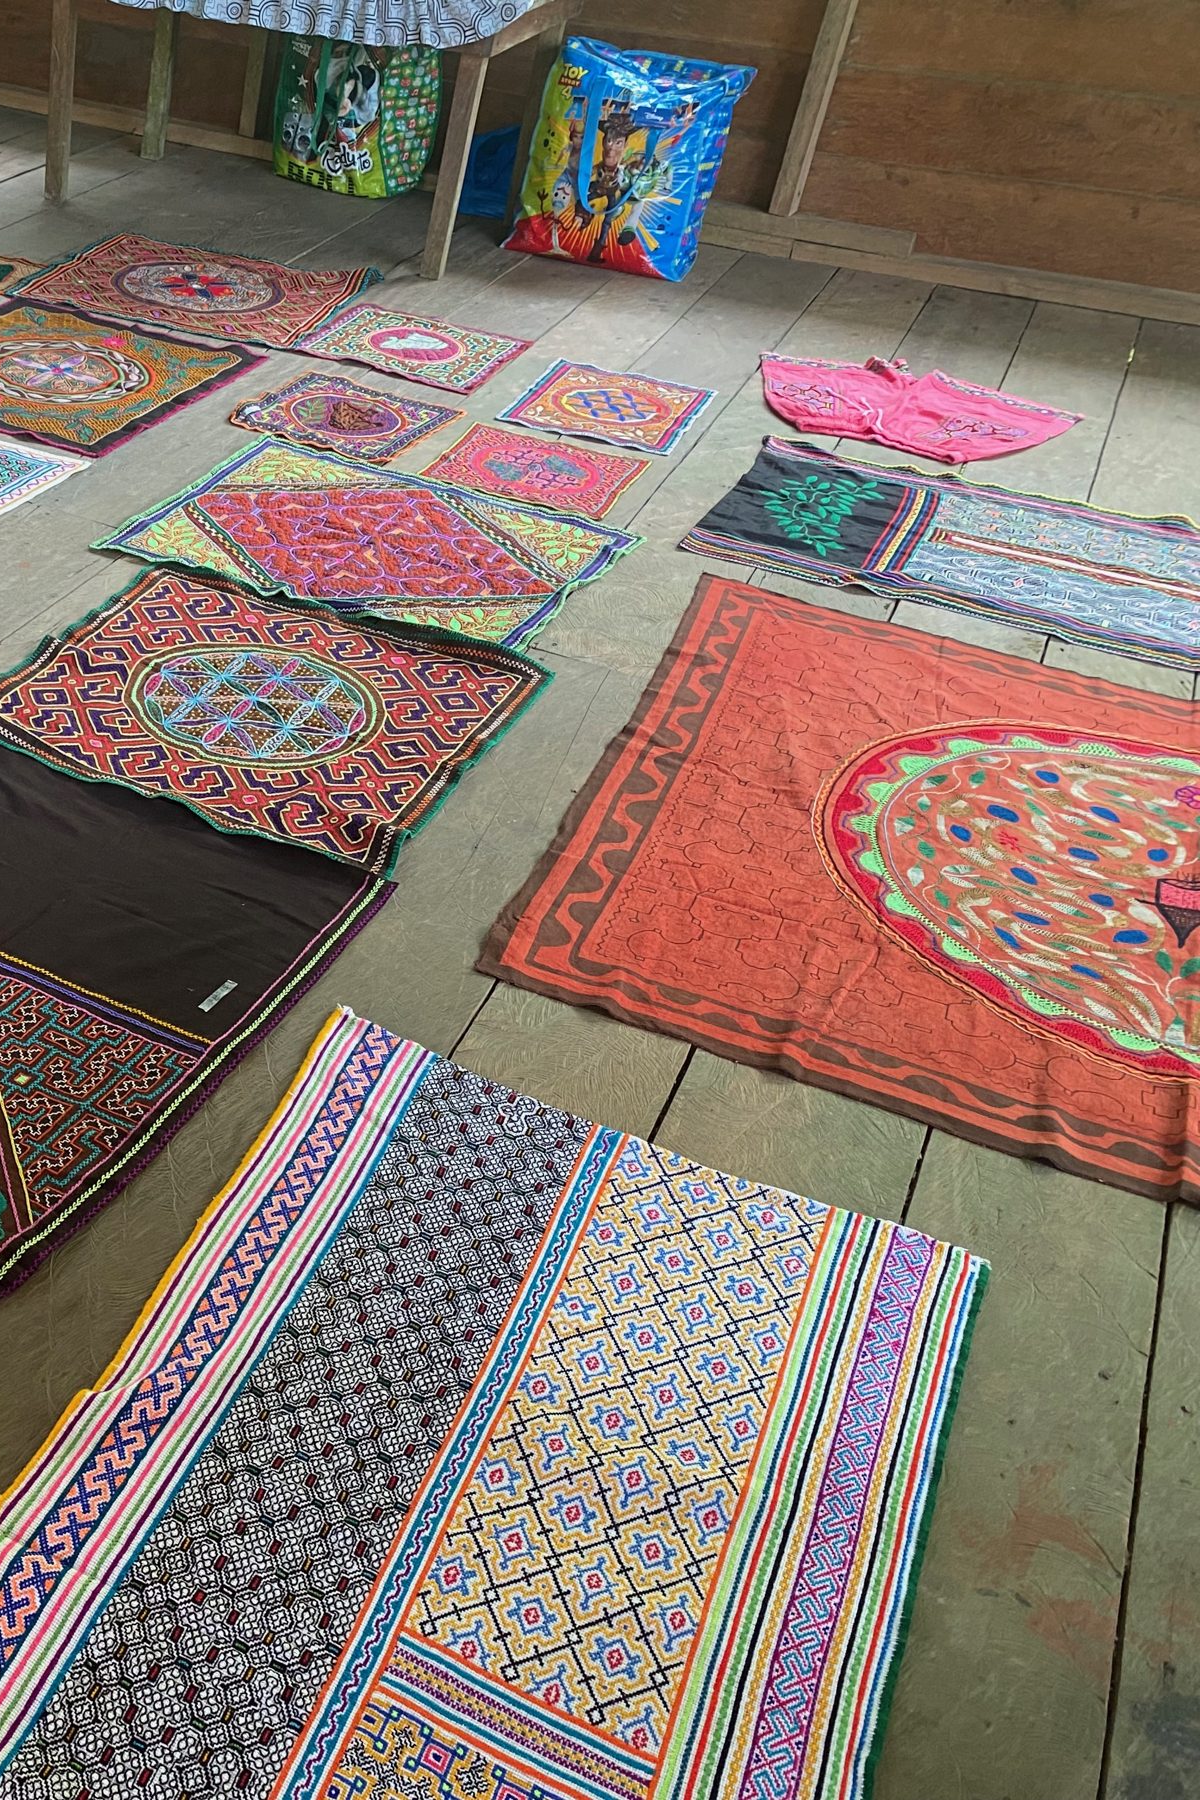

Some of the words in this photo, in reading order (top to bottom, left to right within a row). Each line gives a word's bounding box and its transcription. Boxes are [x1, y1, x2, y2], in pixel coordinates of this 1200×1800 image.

[564, 63, 589, 79] TOY
[561, 86, 572, 99] 4
[357, 151, 371, 171] to
